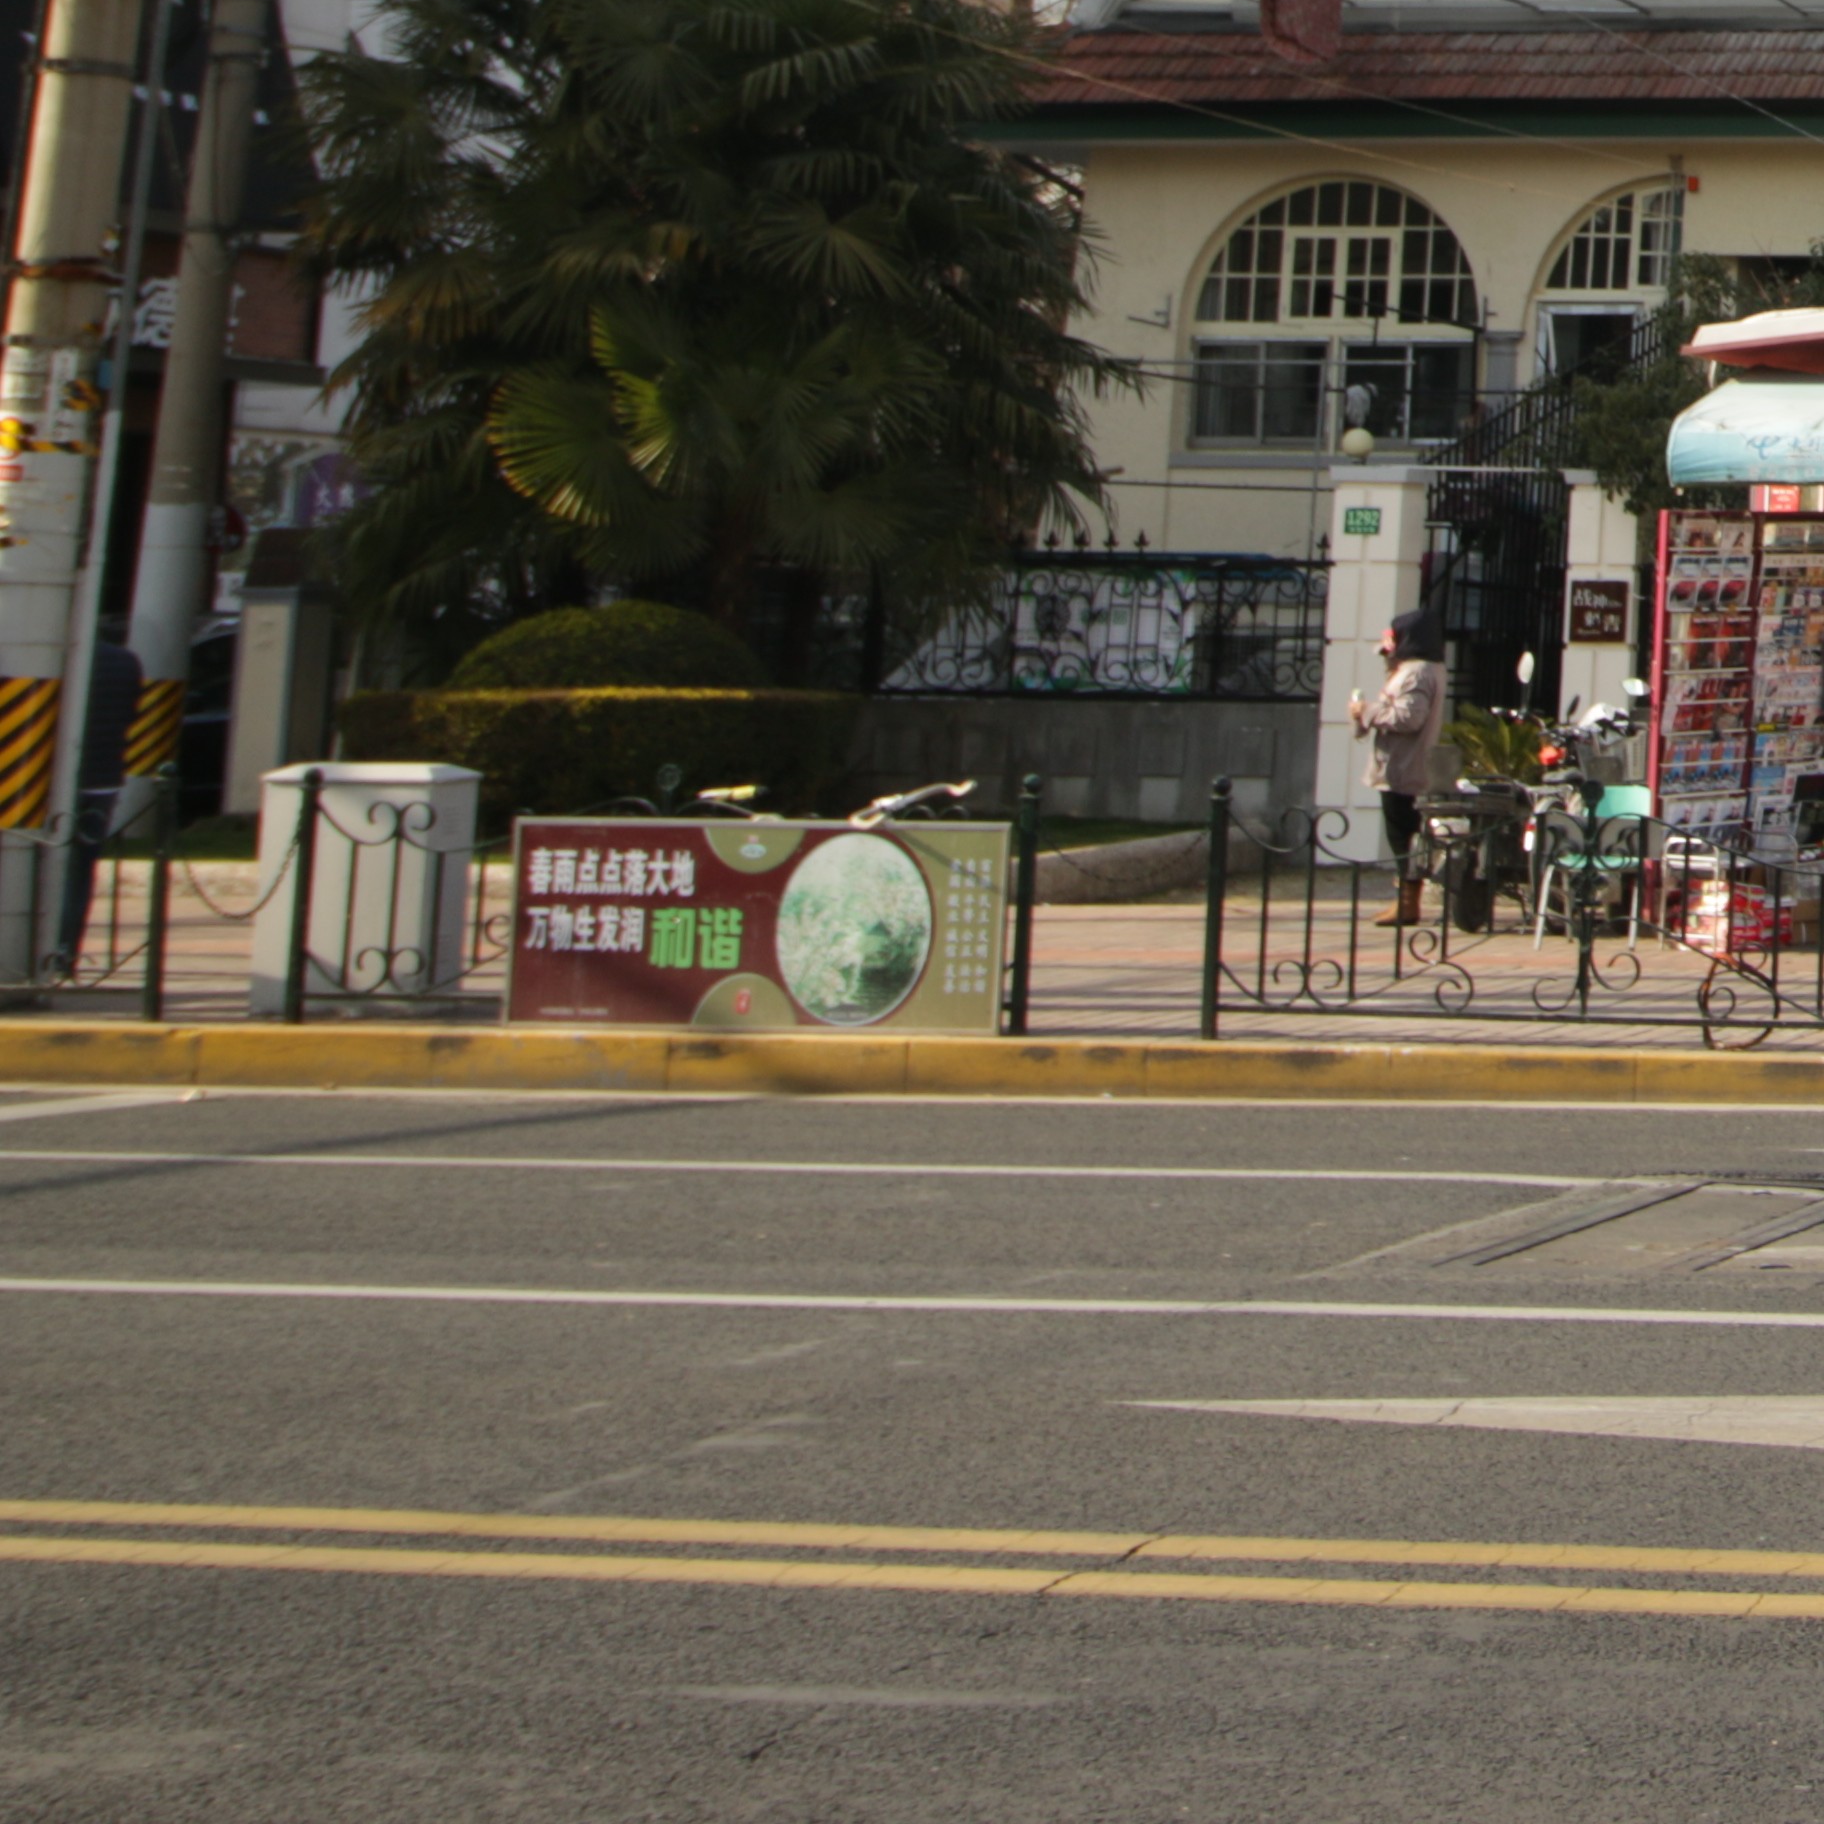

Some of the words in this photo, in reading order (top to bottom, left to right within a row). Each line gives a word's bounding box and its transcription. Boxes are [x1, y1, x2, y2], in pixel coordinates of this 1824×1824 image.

[528, 847, 696, 898] 春雨点点落大地
[524, 904, 646, 953] 万物生发润
[648, 905, 744, 970] 和谐
